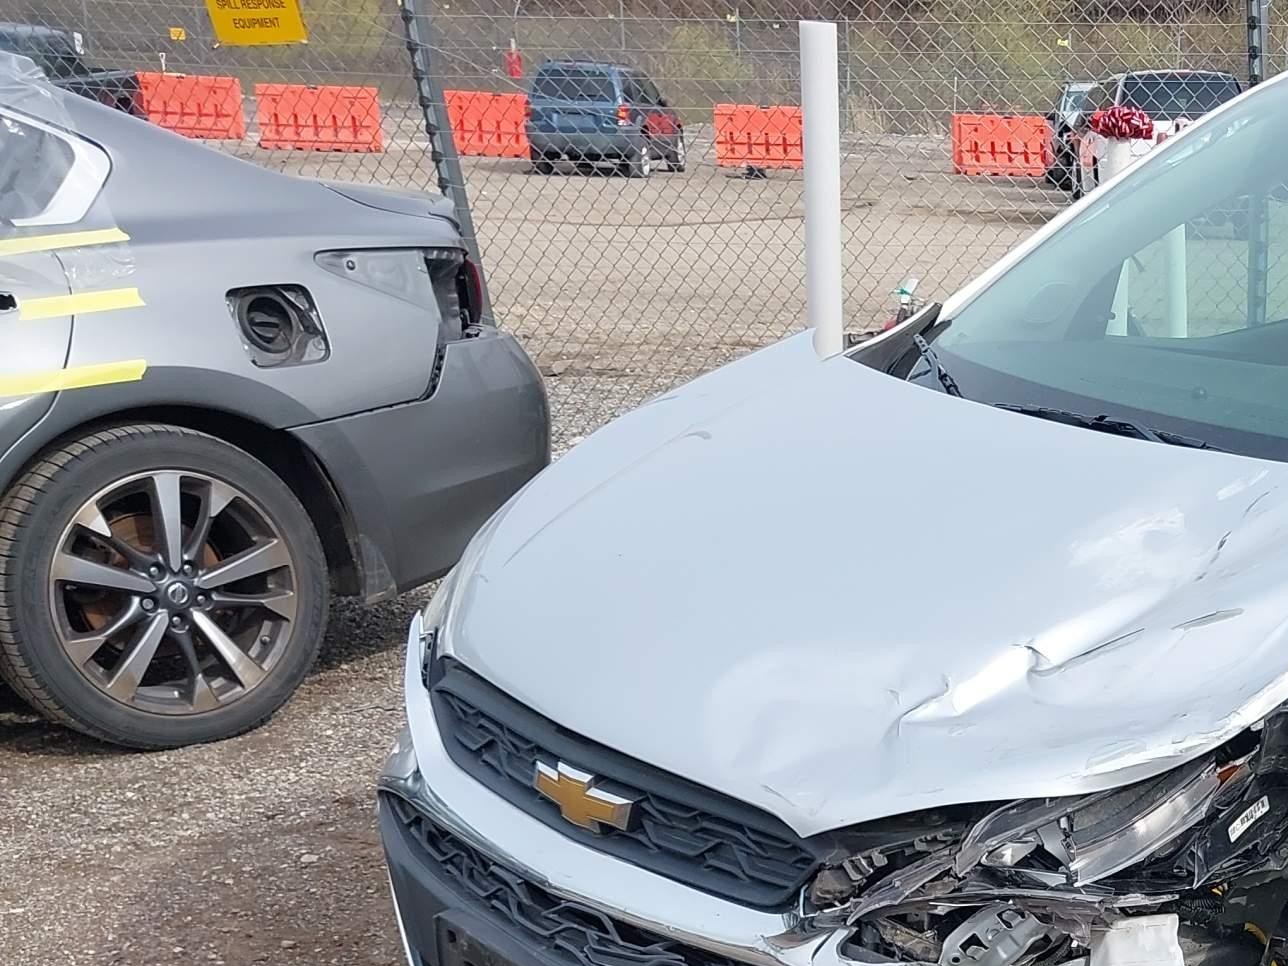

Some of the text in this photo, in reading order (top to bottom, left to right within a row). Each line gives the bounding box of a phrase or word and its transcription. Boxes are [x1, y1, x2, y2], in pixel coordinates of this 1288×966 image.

[216, 0, 287, 9] SPILL RESPONSE
[233, 17, 281, 29] EQUIPMENT
